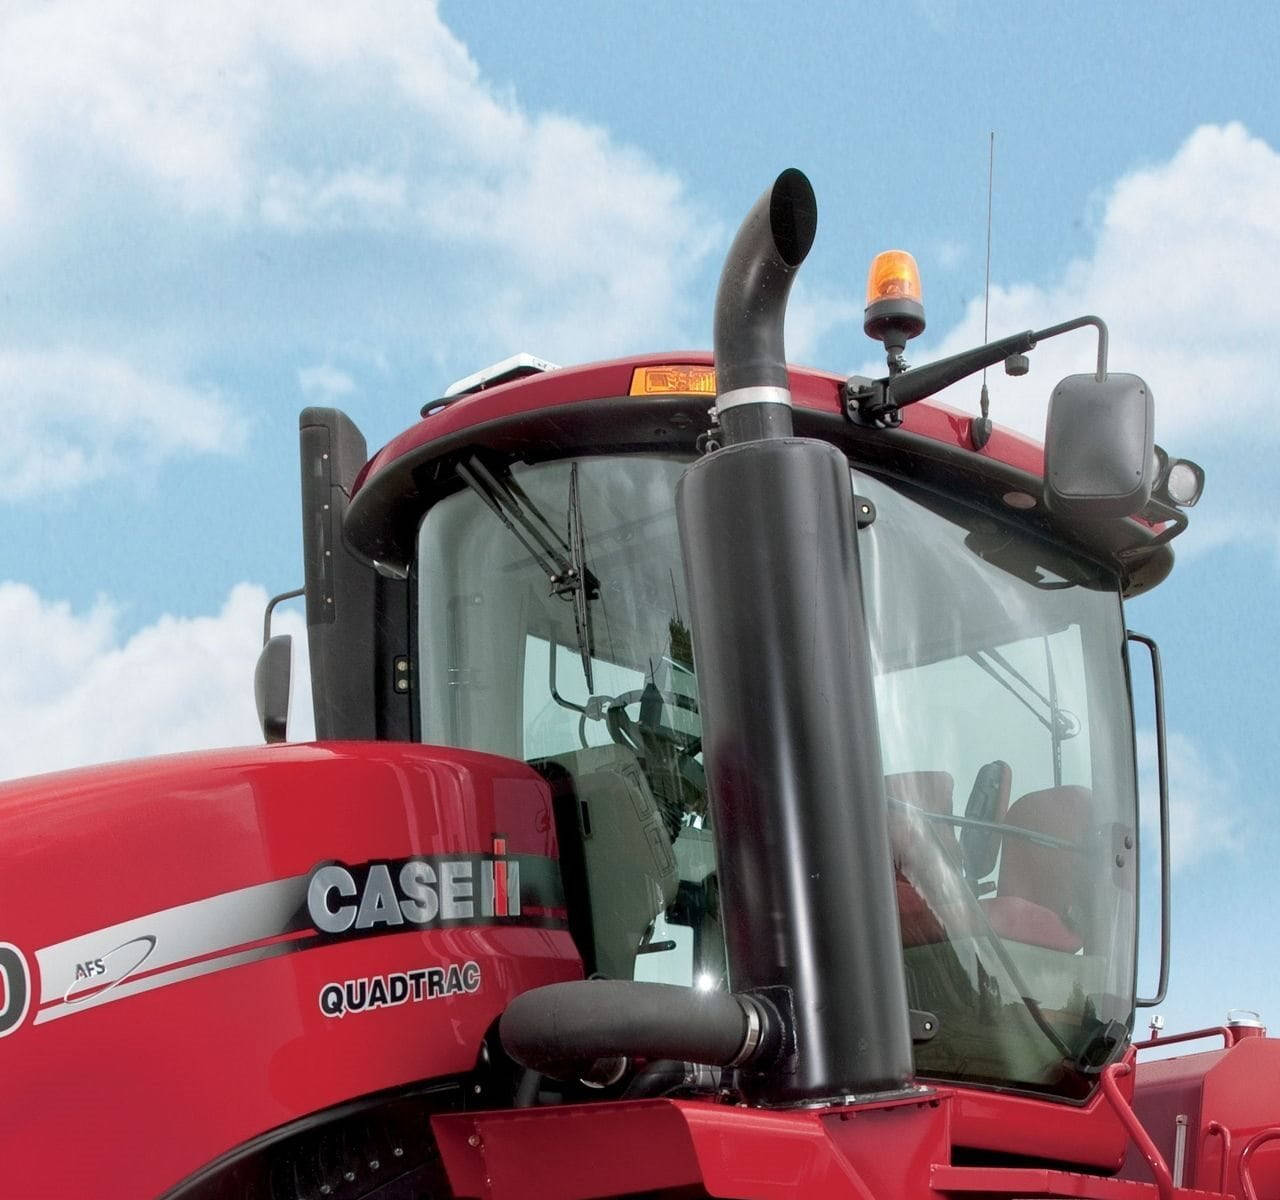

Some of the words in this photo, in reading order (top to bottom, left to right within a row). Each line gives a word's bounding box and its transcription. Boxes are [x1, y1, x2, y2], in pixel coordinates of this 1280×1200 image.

[308, 860, 474, 933] CASE
[75, 959, 106, 980] AFS
[319, 961, 480, 1018] QUADTRAC
